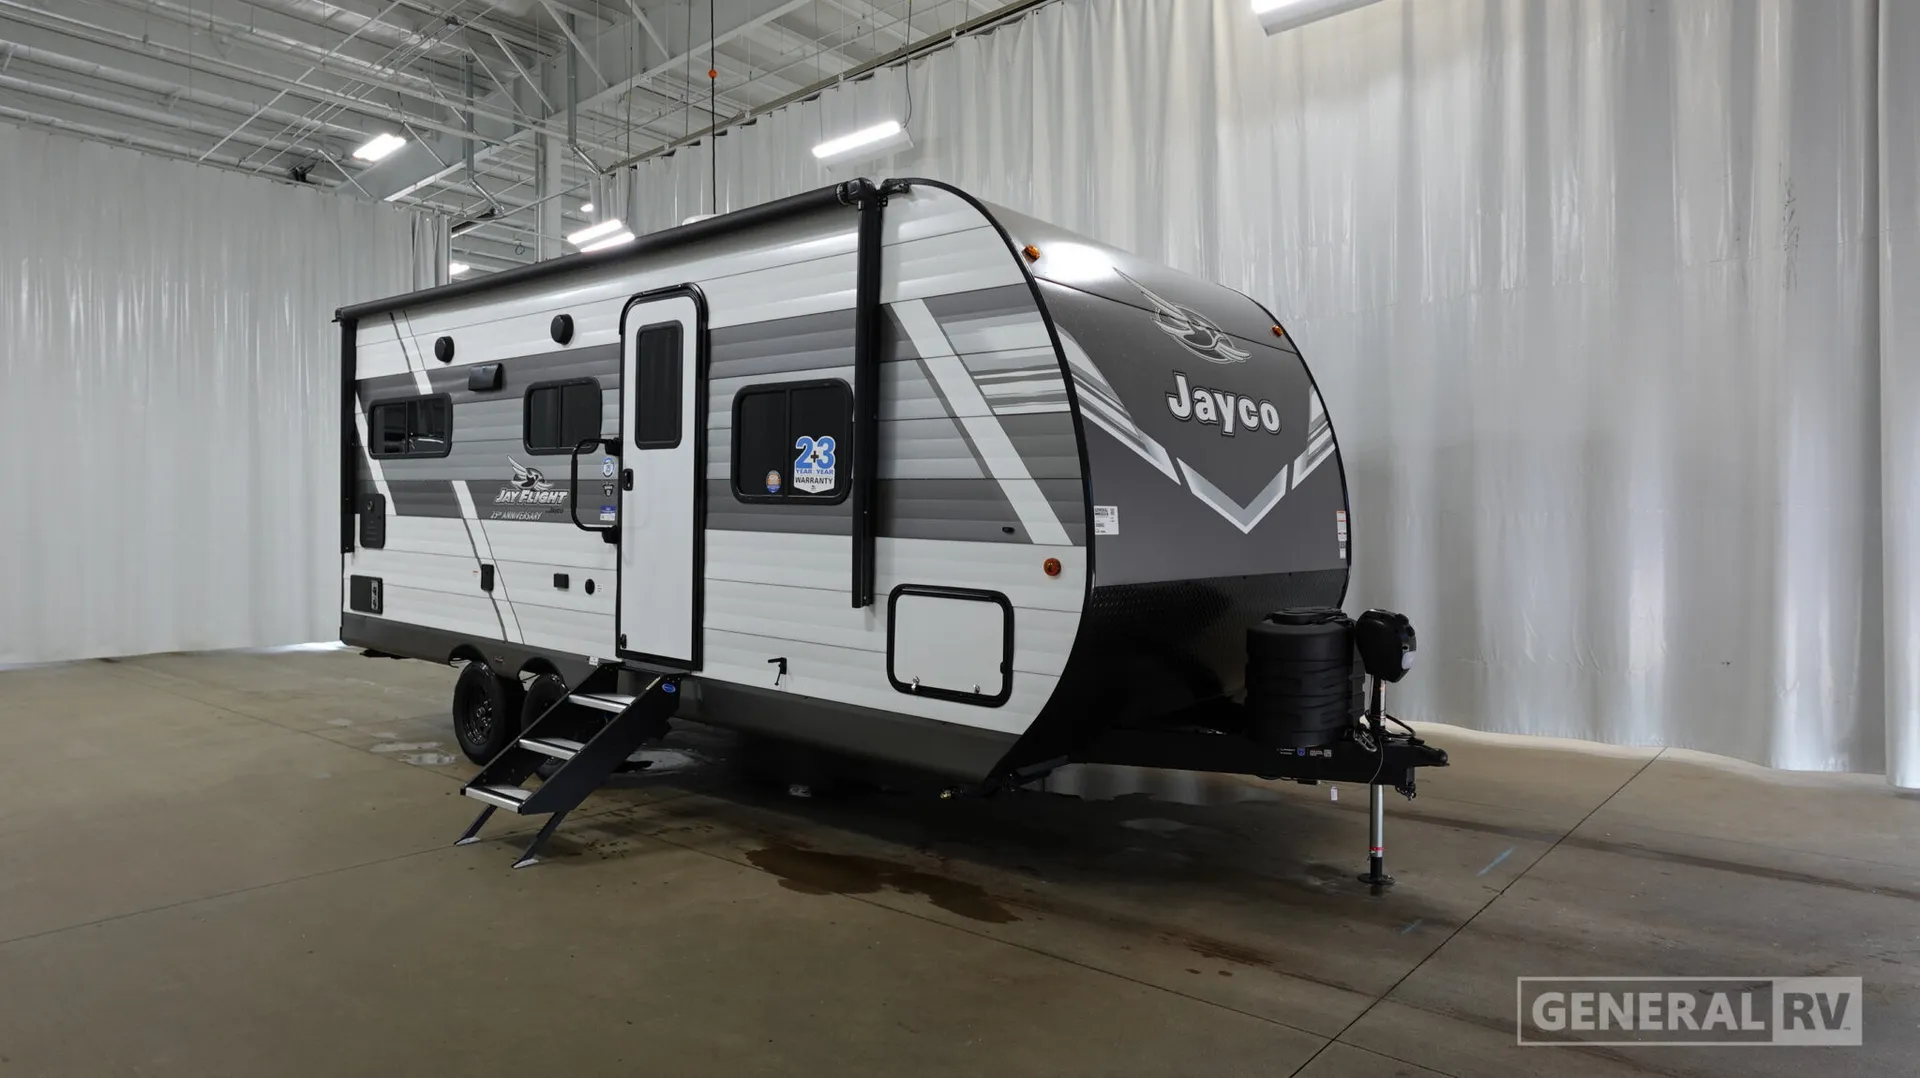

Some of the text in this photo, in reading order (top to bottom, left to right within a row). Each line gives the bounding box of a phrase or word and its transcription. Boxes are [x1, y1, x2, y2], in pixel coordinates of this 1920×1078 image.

[1165, 370, 1282, 437] Jayco
[795, 477, 833, 485] WARRANTY
[494, 489, 568, 504] JAY FLIGHT
[502, 511, 543, 520] ANNIVERSARY
